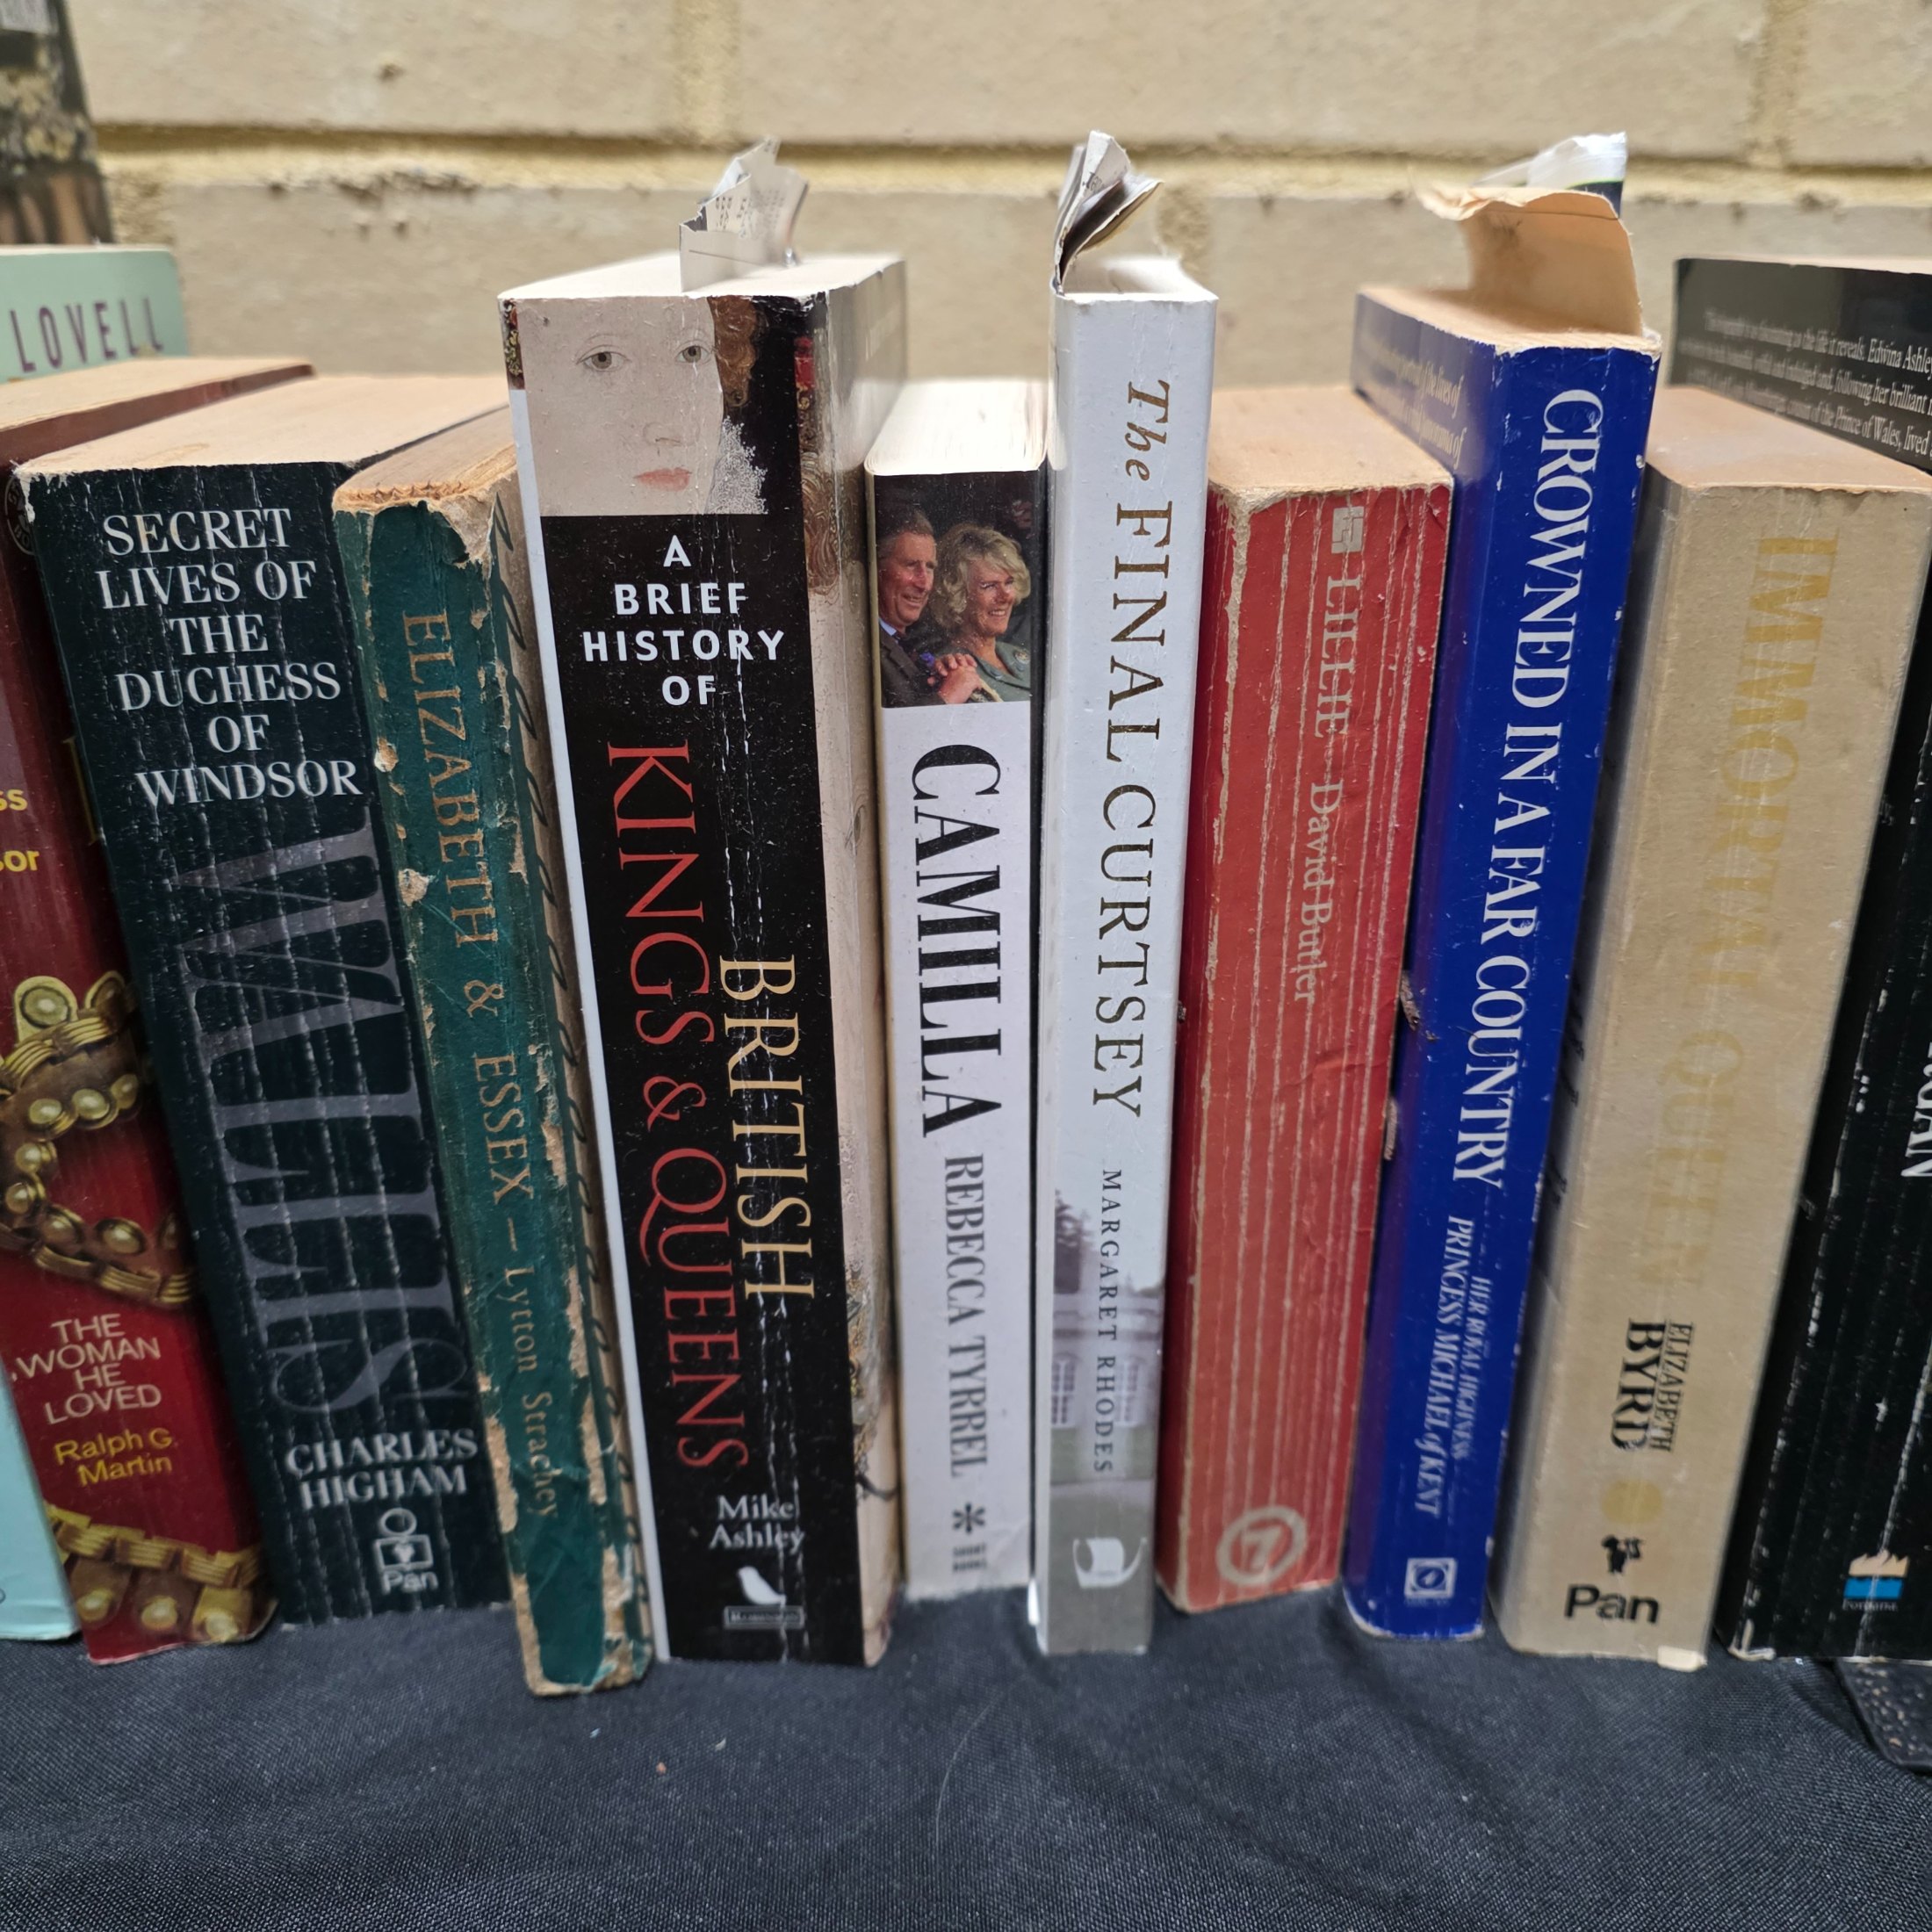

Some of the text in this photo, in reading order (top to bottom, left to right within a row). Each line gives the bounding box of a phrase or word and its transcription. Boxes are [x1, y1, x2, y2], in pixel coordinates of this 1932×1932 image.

[10, 297, 163, 372] LOVELL
[1835, 335, 1864, 361] reveals.
[1867, 338, 1900, 368] Edwina
[1451, 374, 1465, 420] of
[1834, 370, 1872, 406] following
[1872, 378, 1890, 404] her
[1890, 381, 1927, 414] brilliant
[1453, 427, 1467, 470] of
[1834, 406, 1861, 434] Prince
[1862, 415, 1874, 438] of
[1873, 415, 1901, 452] Wales,
[1903, 425, 1930, 456] lived
[102, 508, 292, 556] SECRET
[663, 535, 691, 567] A
[95, 559, 317, 610] LIVES OF
[614, 581, 746, 616] BRIEF
[169, 613, 269, 656] THE
[581, 629, 785, 662] HISTORY
[116, 661, 342, 710] DUCHESS
[661, 674, 716, 706] OF
[208, 714, 270, 753] OF
[1092, 379, 1172, 1118] The FINAL CURTSEY
[134, 760, 364, 806] WINDSOR
[402, 611, 499, 948] ELIZABETH
[1294, 574, 1361, 1002] LILLIE David Butler
[1453, 389, 1604, 1189] CROWNED IN A FAR COUNTRY
[0, 849, 40, 873] or
[464, 978, 505, 1019] &
[176, 805, 471, 1412] WALLIS
[607, 739, 749, 1468] KINGS & QUEENS
[912, 744, 1002, 1480] CAMILLA REBECCA TYRREL
[474, 1051, 536, 1204] ESSEX
[719, 954, 816, 1301] BRITISH
[1467, 1275, 1492, 1316] HER
[50, 1313, 126, 1344] THE
[496, 1265, 537, 1373] Lytton
[1092, 1168, 1122, 1474] MARGARET RHODES
[16, 1337, 162, 1379] WOMAN
[74, 1362, 126, 1391] HE
[1413, 1215, 1475, 1520] PRINCESS MICHAEL of KENT
[45, 1384, 162, 1424] LOVED
[1611, 1317, 1668, 1451] BYRD
[1648, 1320, 1695, 1453] ELIZABETH
[54, 1429, 144, 1465] Ralph
[77, 1453, 173, 1487] Martin
[285, 1427, 479, 1479] CHARLES
[522, 1391, 563, 1518] Strachey
[299, 1463, 467, 1510] HIGHAM
[717, 1493, 795, 1520] Mike
[709, 1522, 805, 1555] Ashley
[381, 1568, 439, 1596] Pan
[1564, 1583, 1661, 1625] Pan
